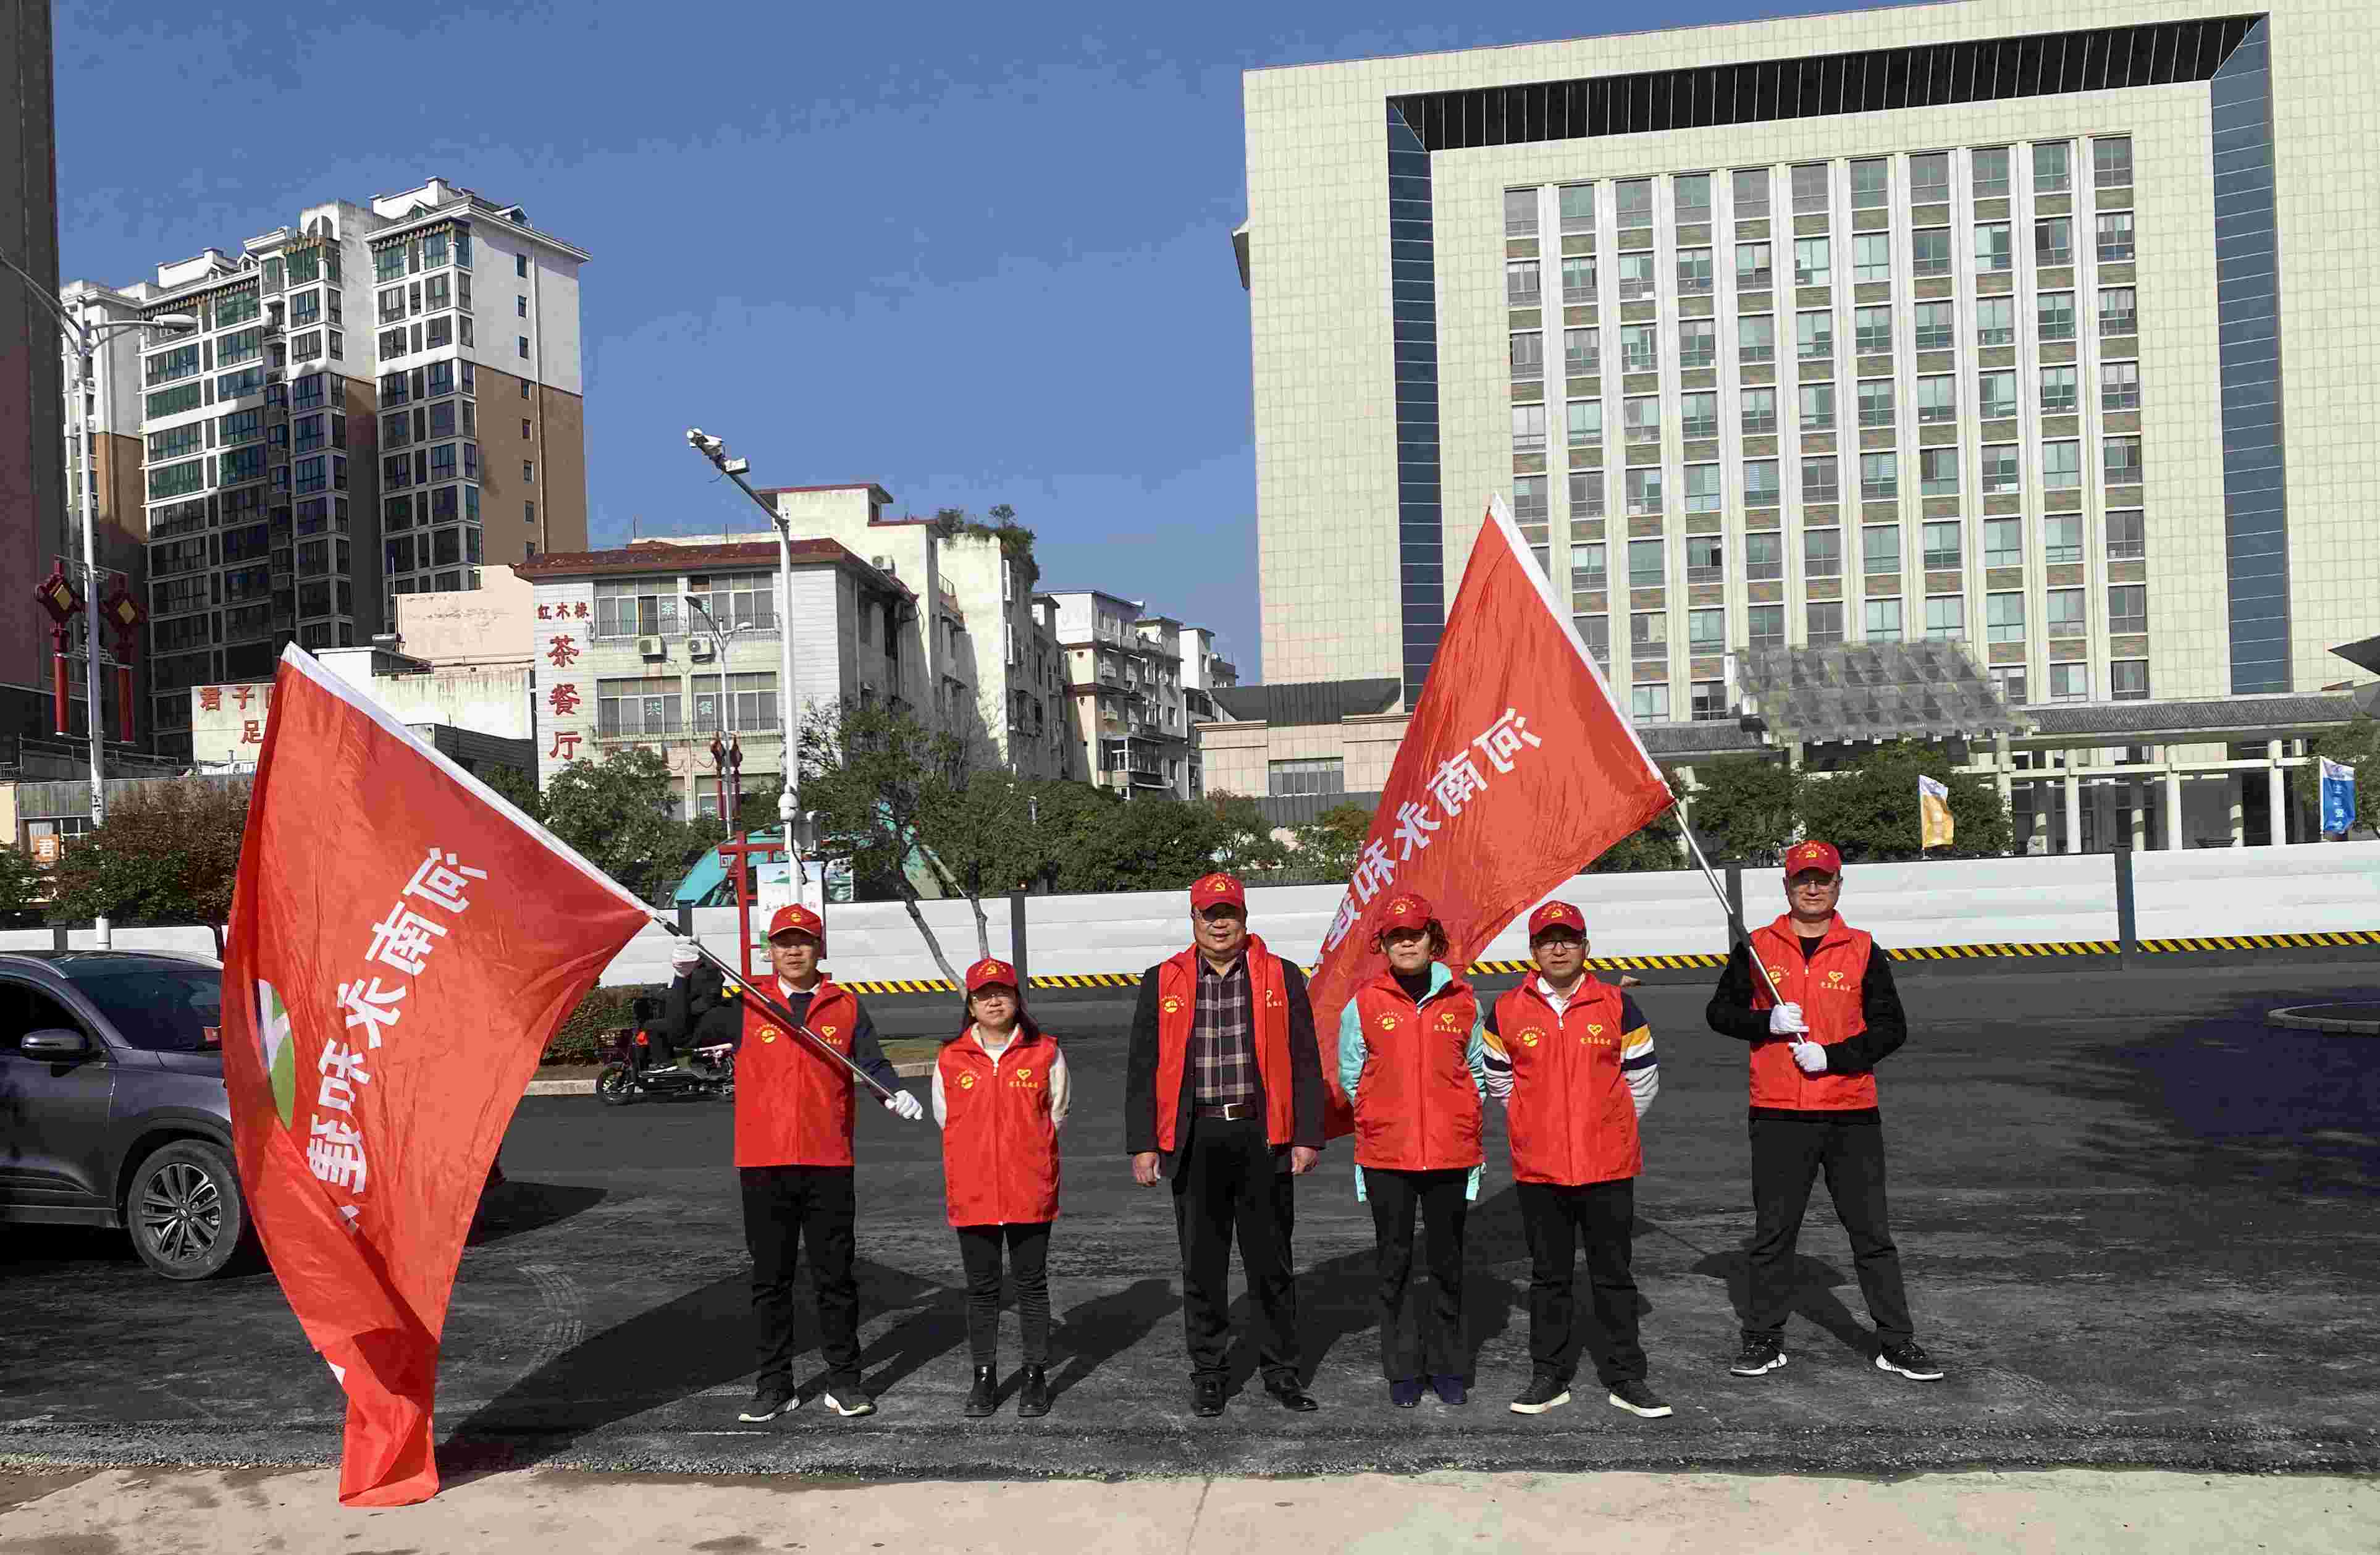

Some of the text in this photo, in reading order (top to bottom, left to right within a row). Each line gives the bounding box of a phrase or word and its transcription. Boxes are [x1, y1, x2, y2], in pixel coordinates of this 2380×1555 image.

[200, 686, 275, 711] 君子
[548, 634, 582, 760] 茶餐厅
